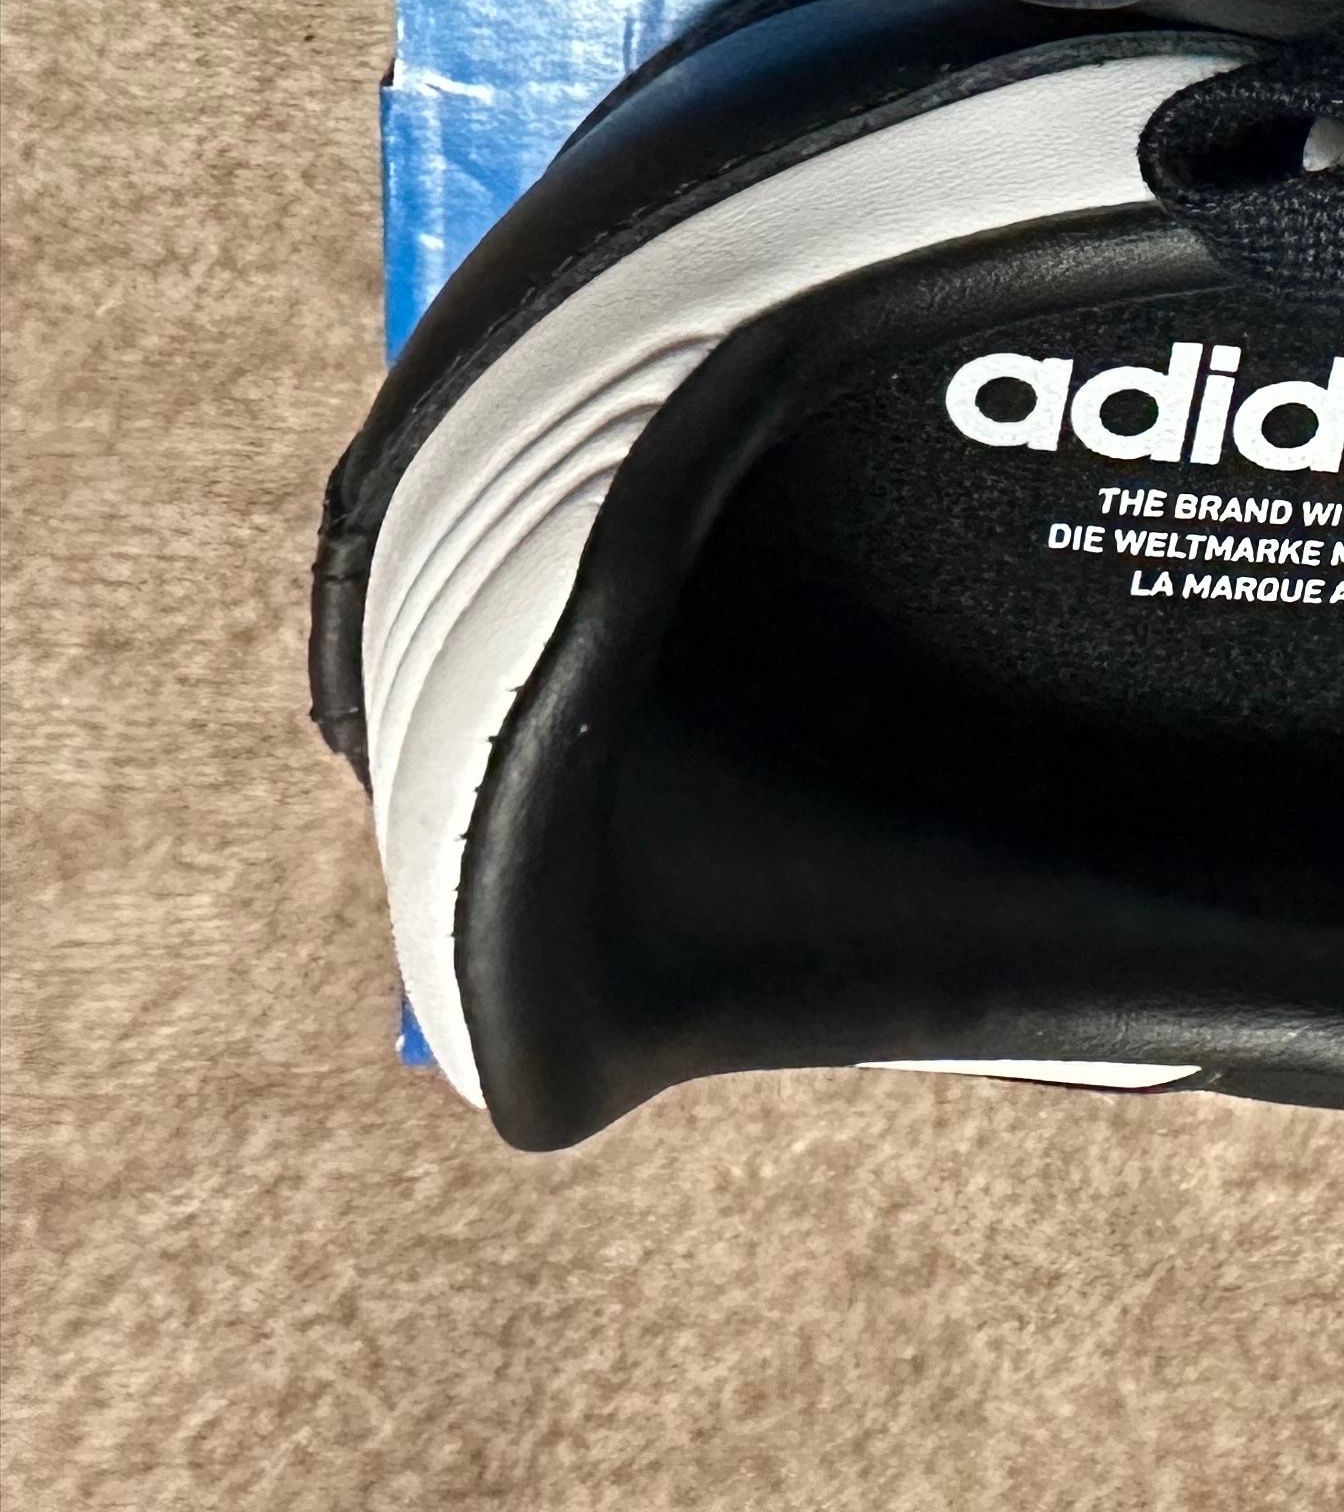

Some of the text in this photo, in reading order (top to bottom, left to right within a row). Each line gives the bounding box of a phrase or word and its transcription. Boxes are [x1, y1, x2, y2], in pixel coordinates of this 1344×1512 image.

[1099, 487, 1167, 517] THE
[1175, 494, 1292, 524] BRAND
[1048, 523, 1105, 553] DIE
[1115, 529, 1324, 566] WELTMARKE
[1131, 570, 1173, 596] LA
[1182, 574, 1325, 603] MARQUE
